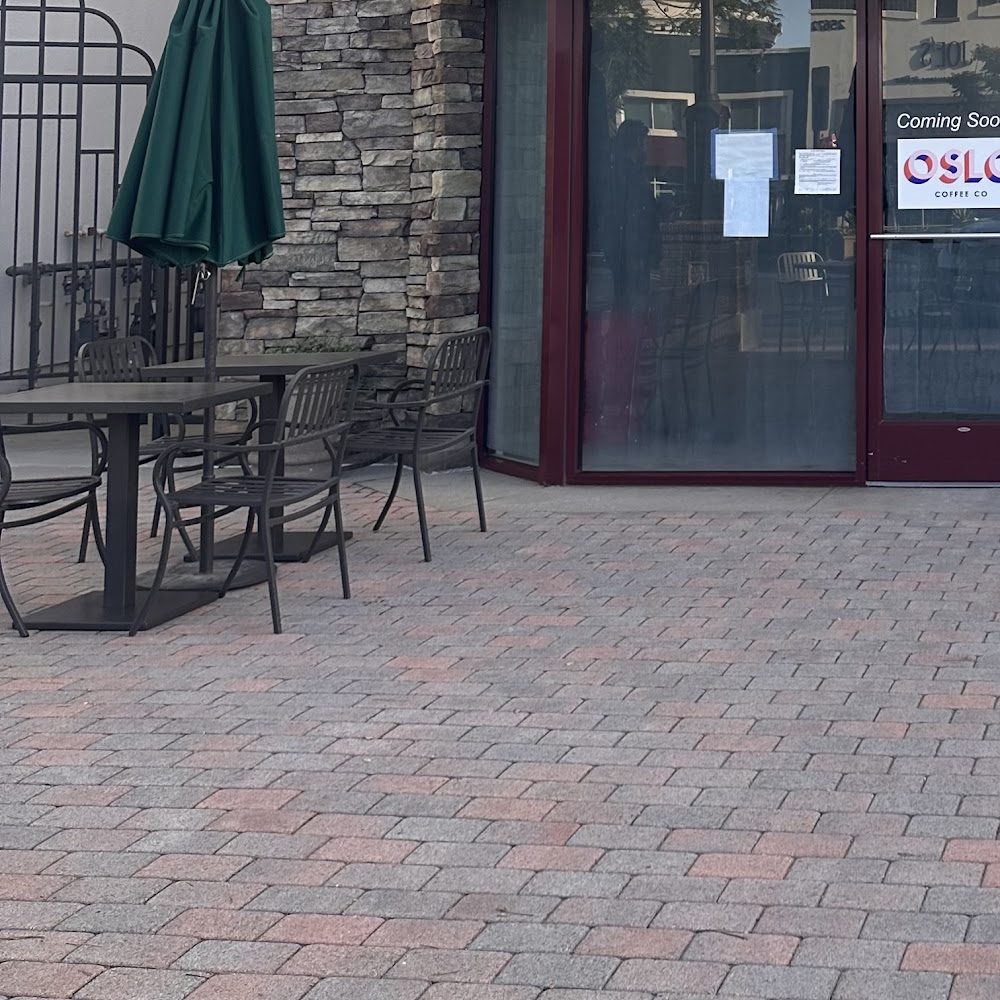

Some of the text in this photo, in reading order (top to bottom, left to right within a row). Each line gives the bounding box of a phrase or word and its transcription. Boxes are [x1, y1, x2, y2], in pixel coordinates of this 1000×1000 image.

[897, 112, 961, 132] Coming
[934, 190, 988, 198] COFFEE CO
